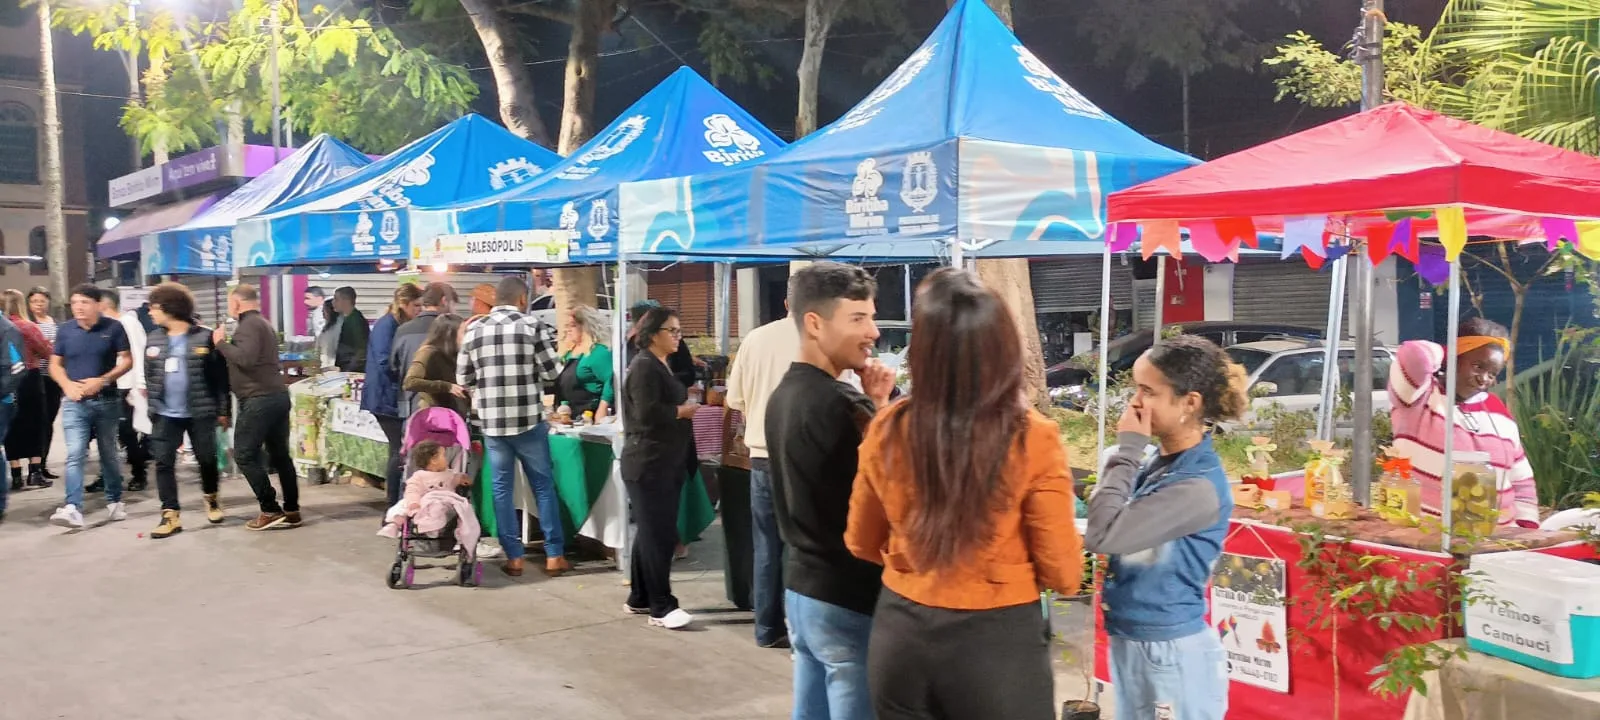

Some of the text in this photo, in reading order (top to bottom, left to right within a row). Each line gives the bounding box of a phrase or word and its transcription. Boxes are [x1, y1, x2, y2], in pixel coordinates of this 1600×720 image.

[466, 239, 523, 253] SALESÓPOLIS
[1486, 601, 1541, 624] Temos
[1482, 623, 1551, 652] Cambuci
